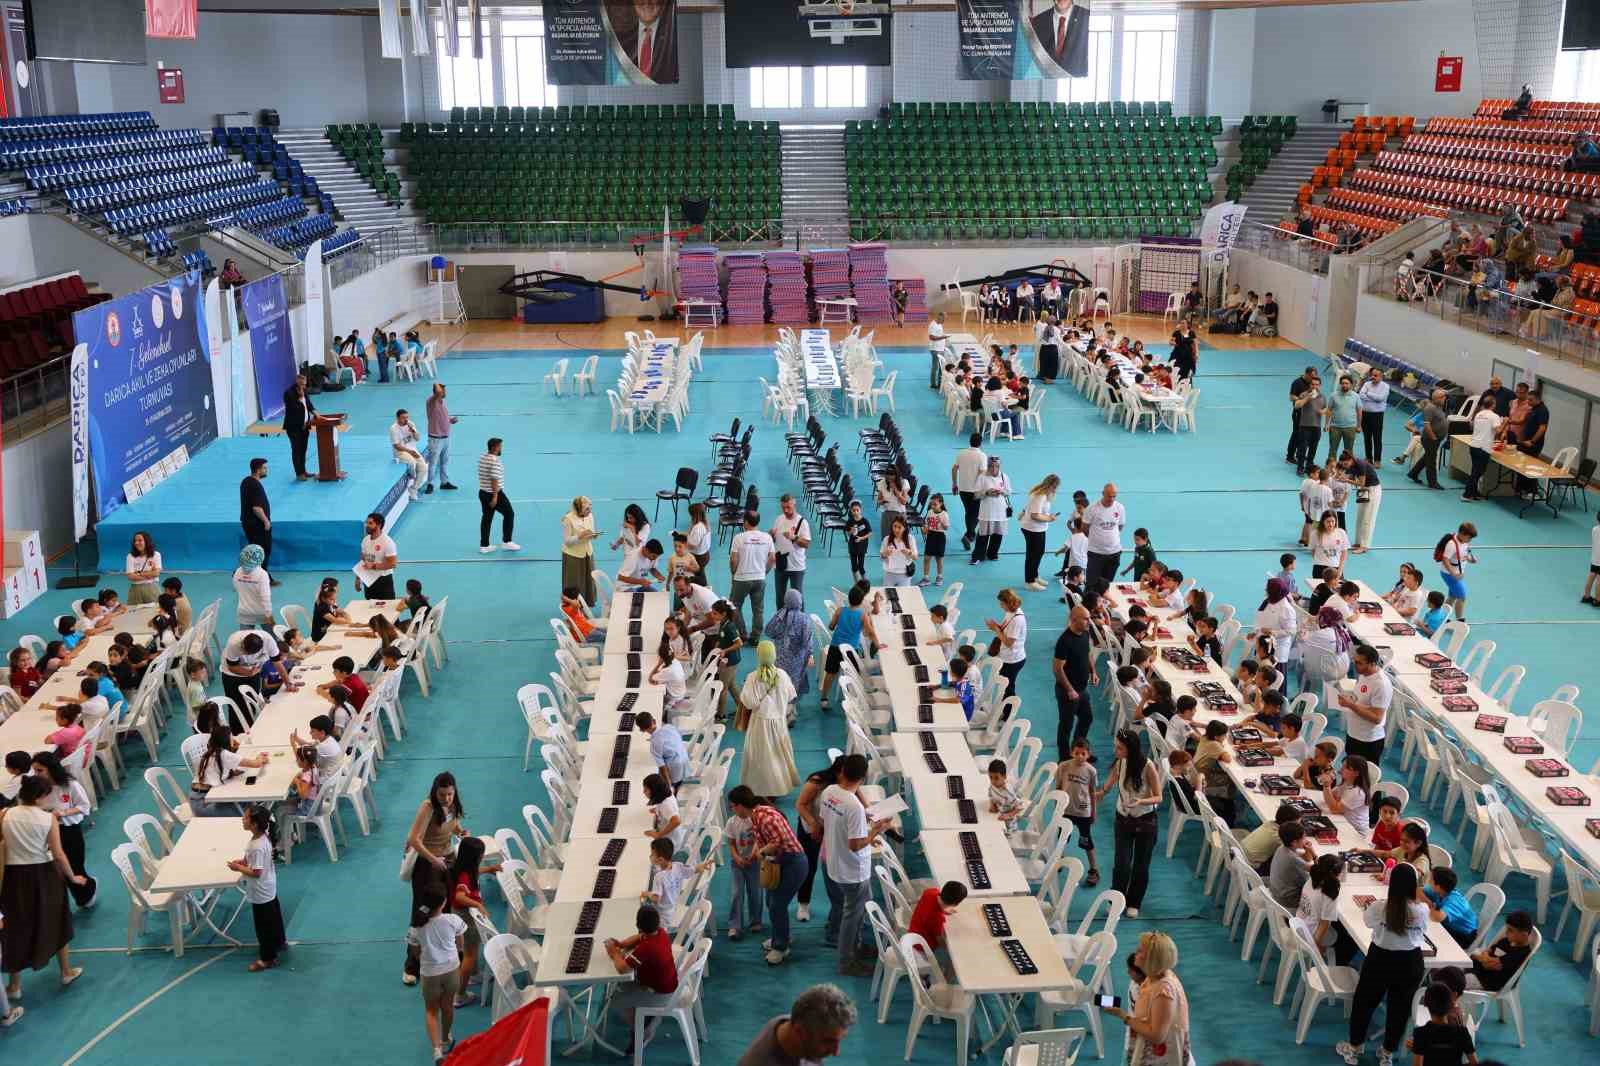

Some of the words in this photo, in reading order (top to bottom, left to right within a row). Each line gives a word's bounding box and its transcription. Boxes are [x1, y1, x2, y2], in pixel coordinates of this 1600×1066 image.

[105, 383, 131, 408] DARICA
[29, 540, 35, 557] 2
[33, 568, 40, 592] 1
[14, 594, 20, 610] 3
